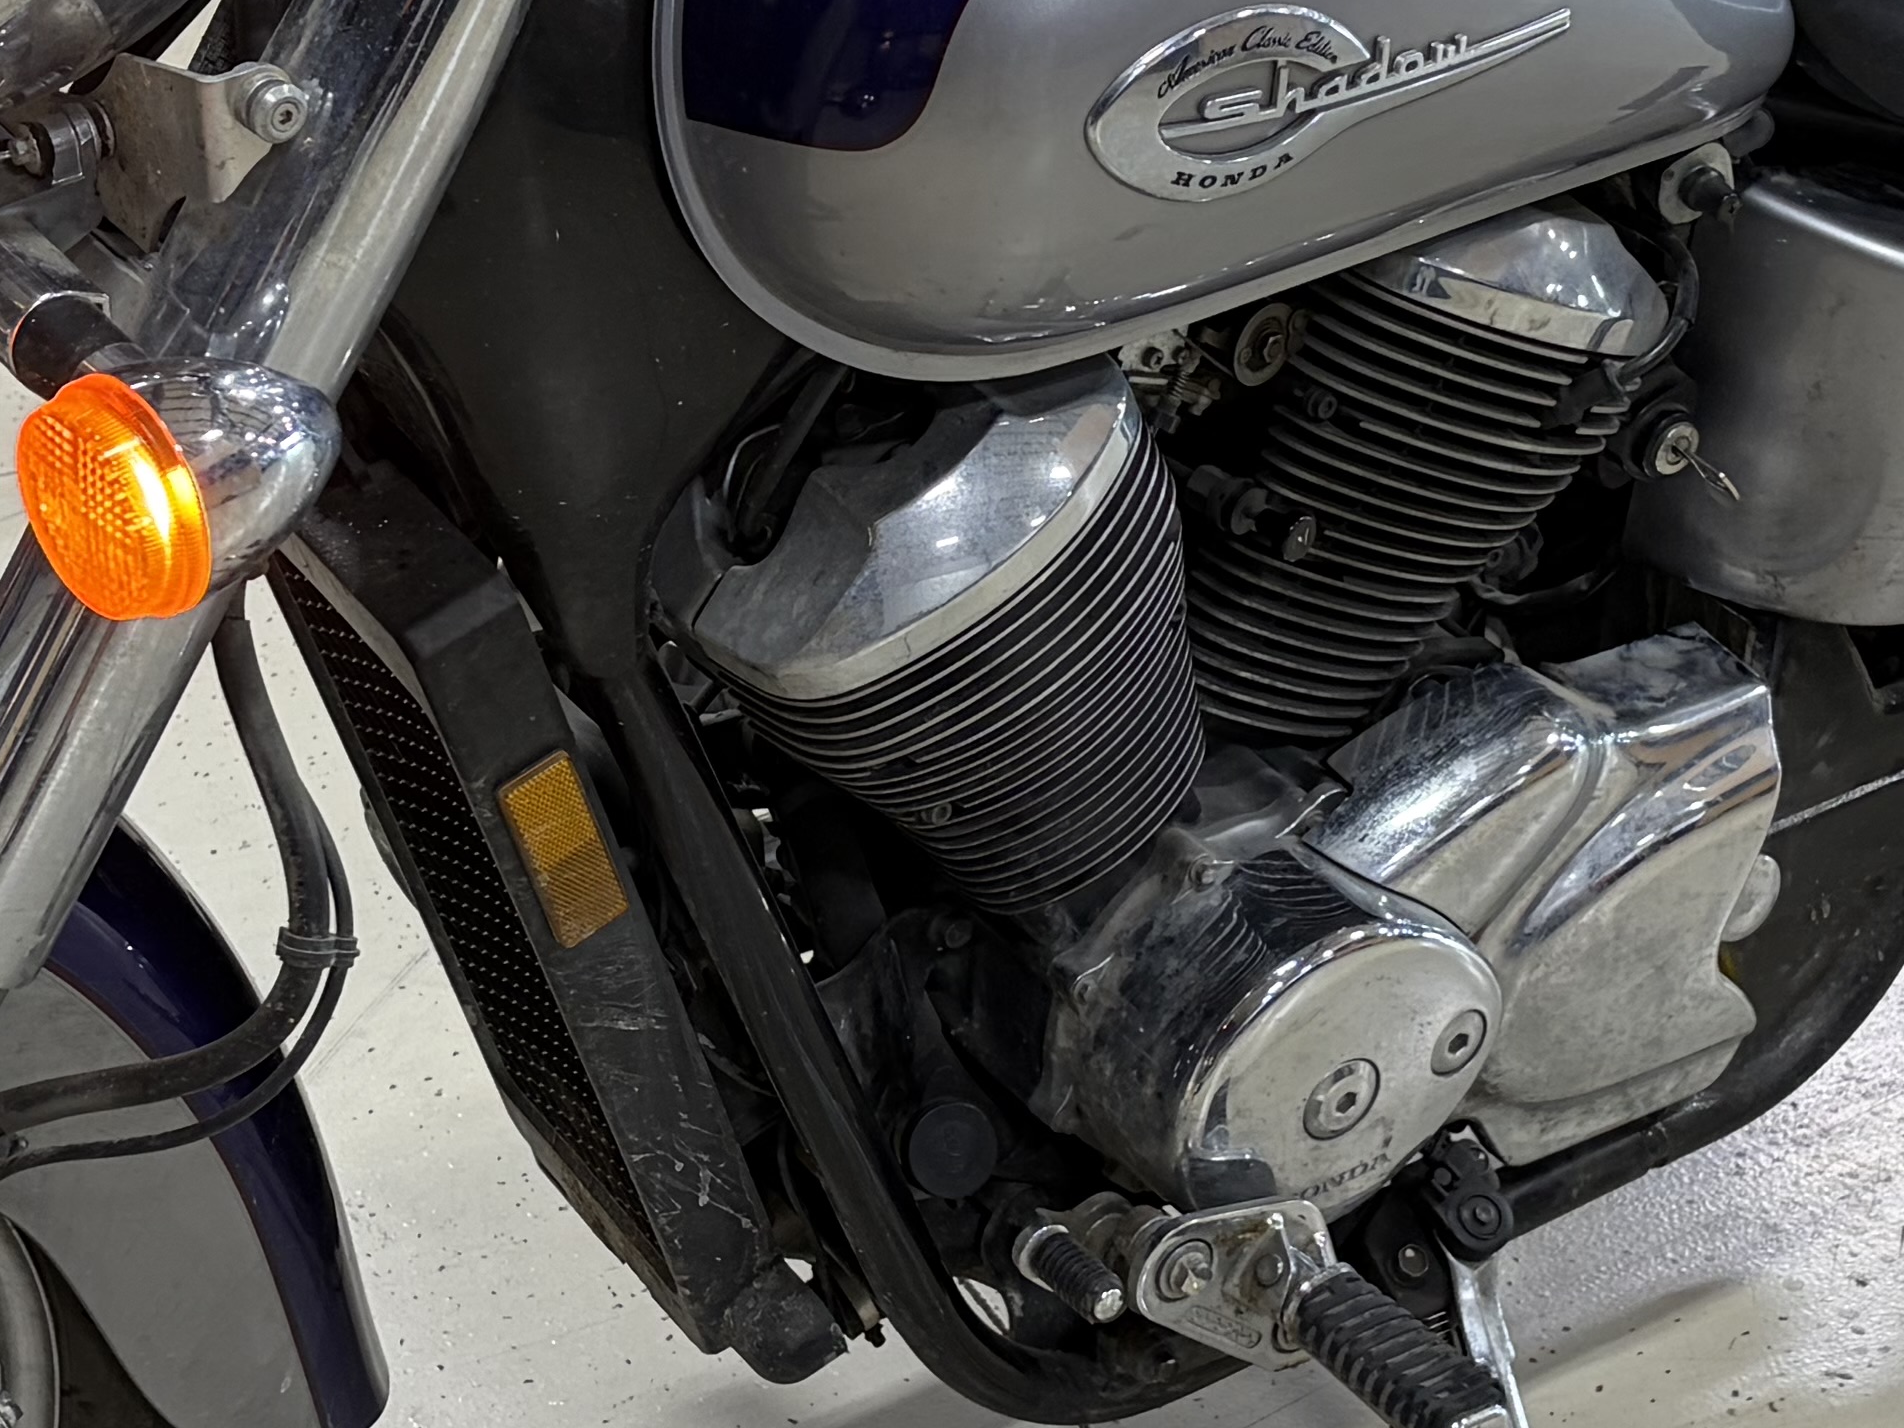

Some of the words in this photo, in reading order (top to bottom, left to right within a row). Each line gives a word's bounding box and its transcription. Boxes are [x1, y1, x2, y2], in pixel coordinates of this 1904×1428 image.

[1240, 25, 1293, 52] Classic
[1170, 152, 1294, 189] HONDA
[1299, 1152, 1392, 1200] ONDA
